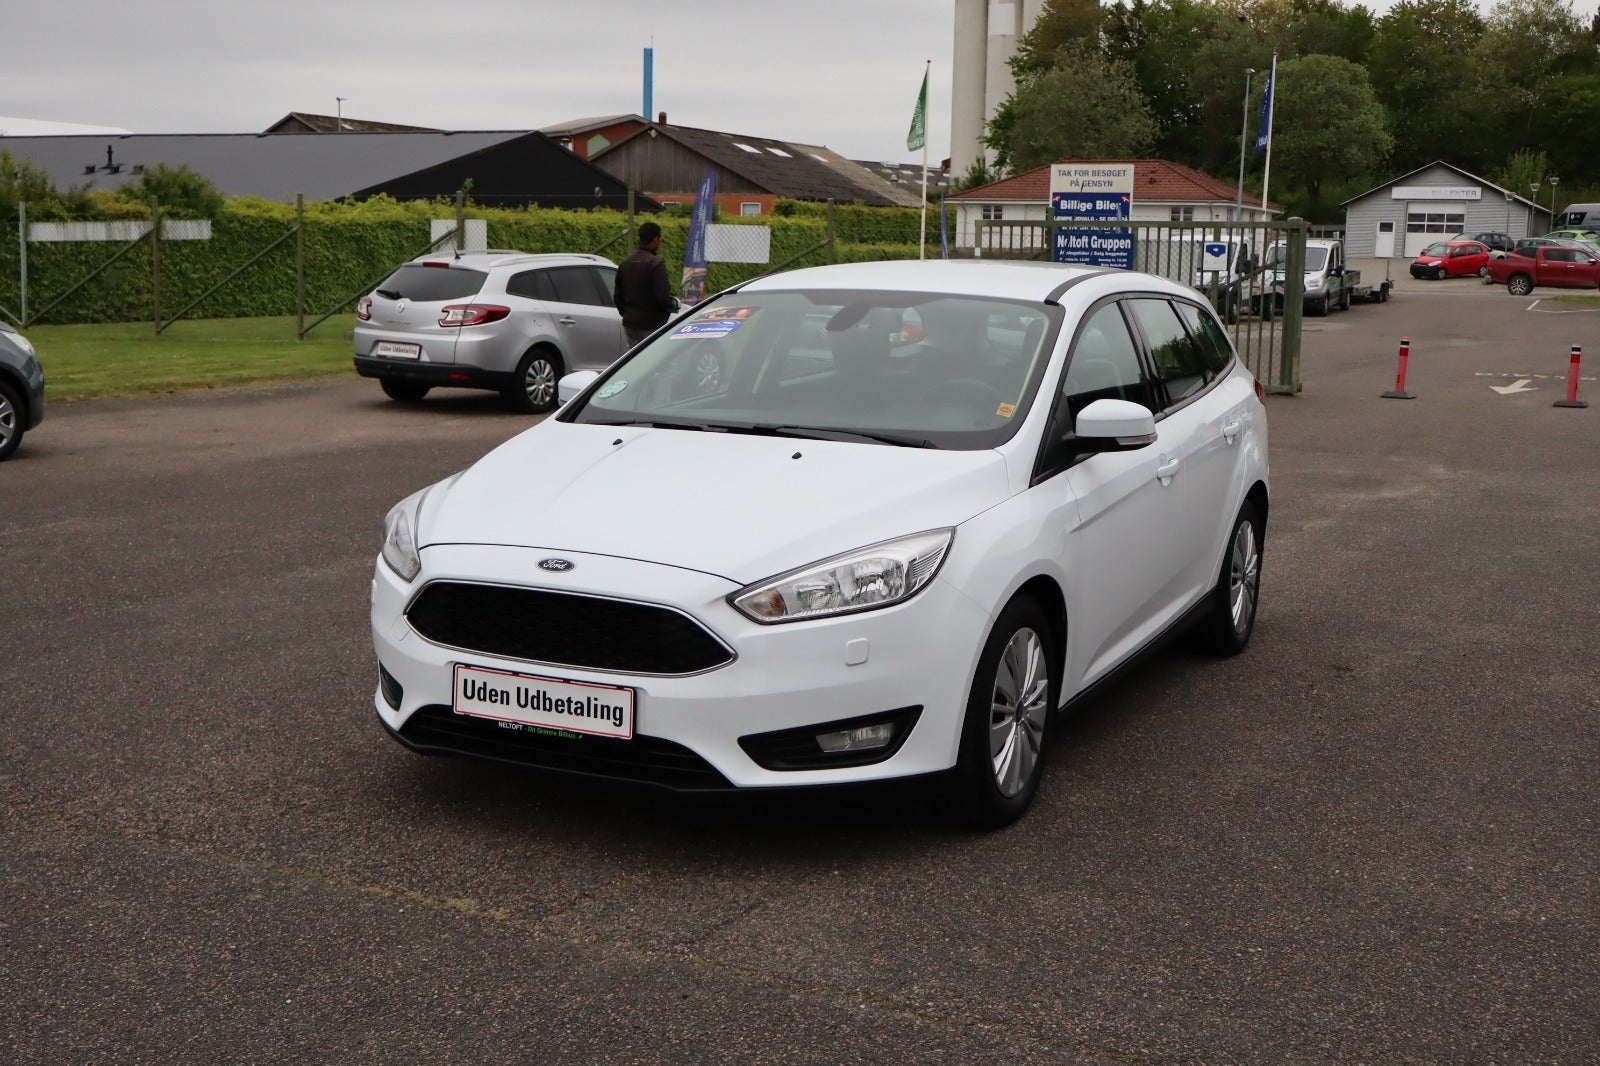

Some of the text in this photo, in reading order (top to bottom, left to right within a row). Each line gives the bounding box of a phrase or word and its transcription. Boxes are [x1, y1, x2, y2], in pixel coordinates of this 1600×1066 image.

[1057, 169, 1127, 177] TAK FOR BESØGET
[1070, 178, 1113, 188] PÅ GENSYN
[1060, 200, 1093, 212] Billige
[1090, 235, 1131, 252] Gruppen
[543, 559, 568, 570] Ford
[463, 678, 624, 728] Uden Udbetaling
[498, 721, 523, 731] NELTOFT
